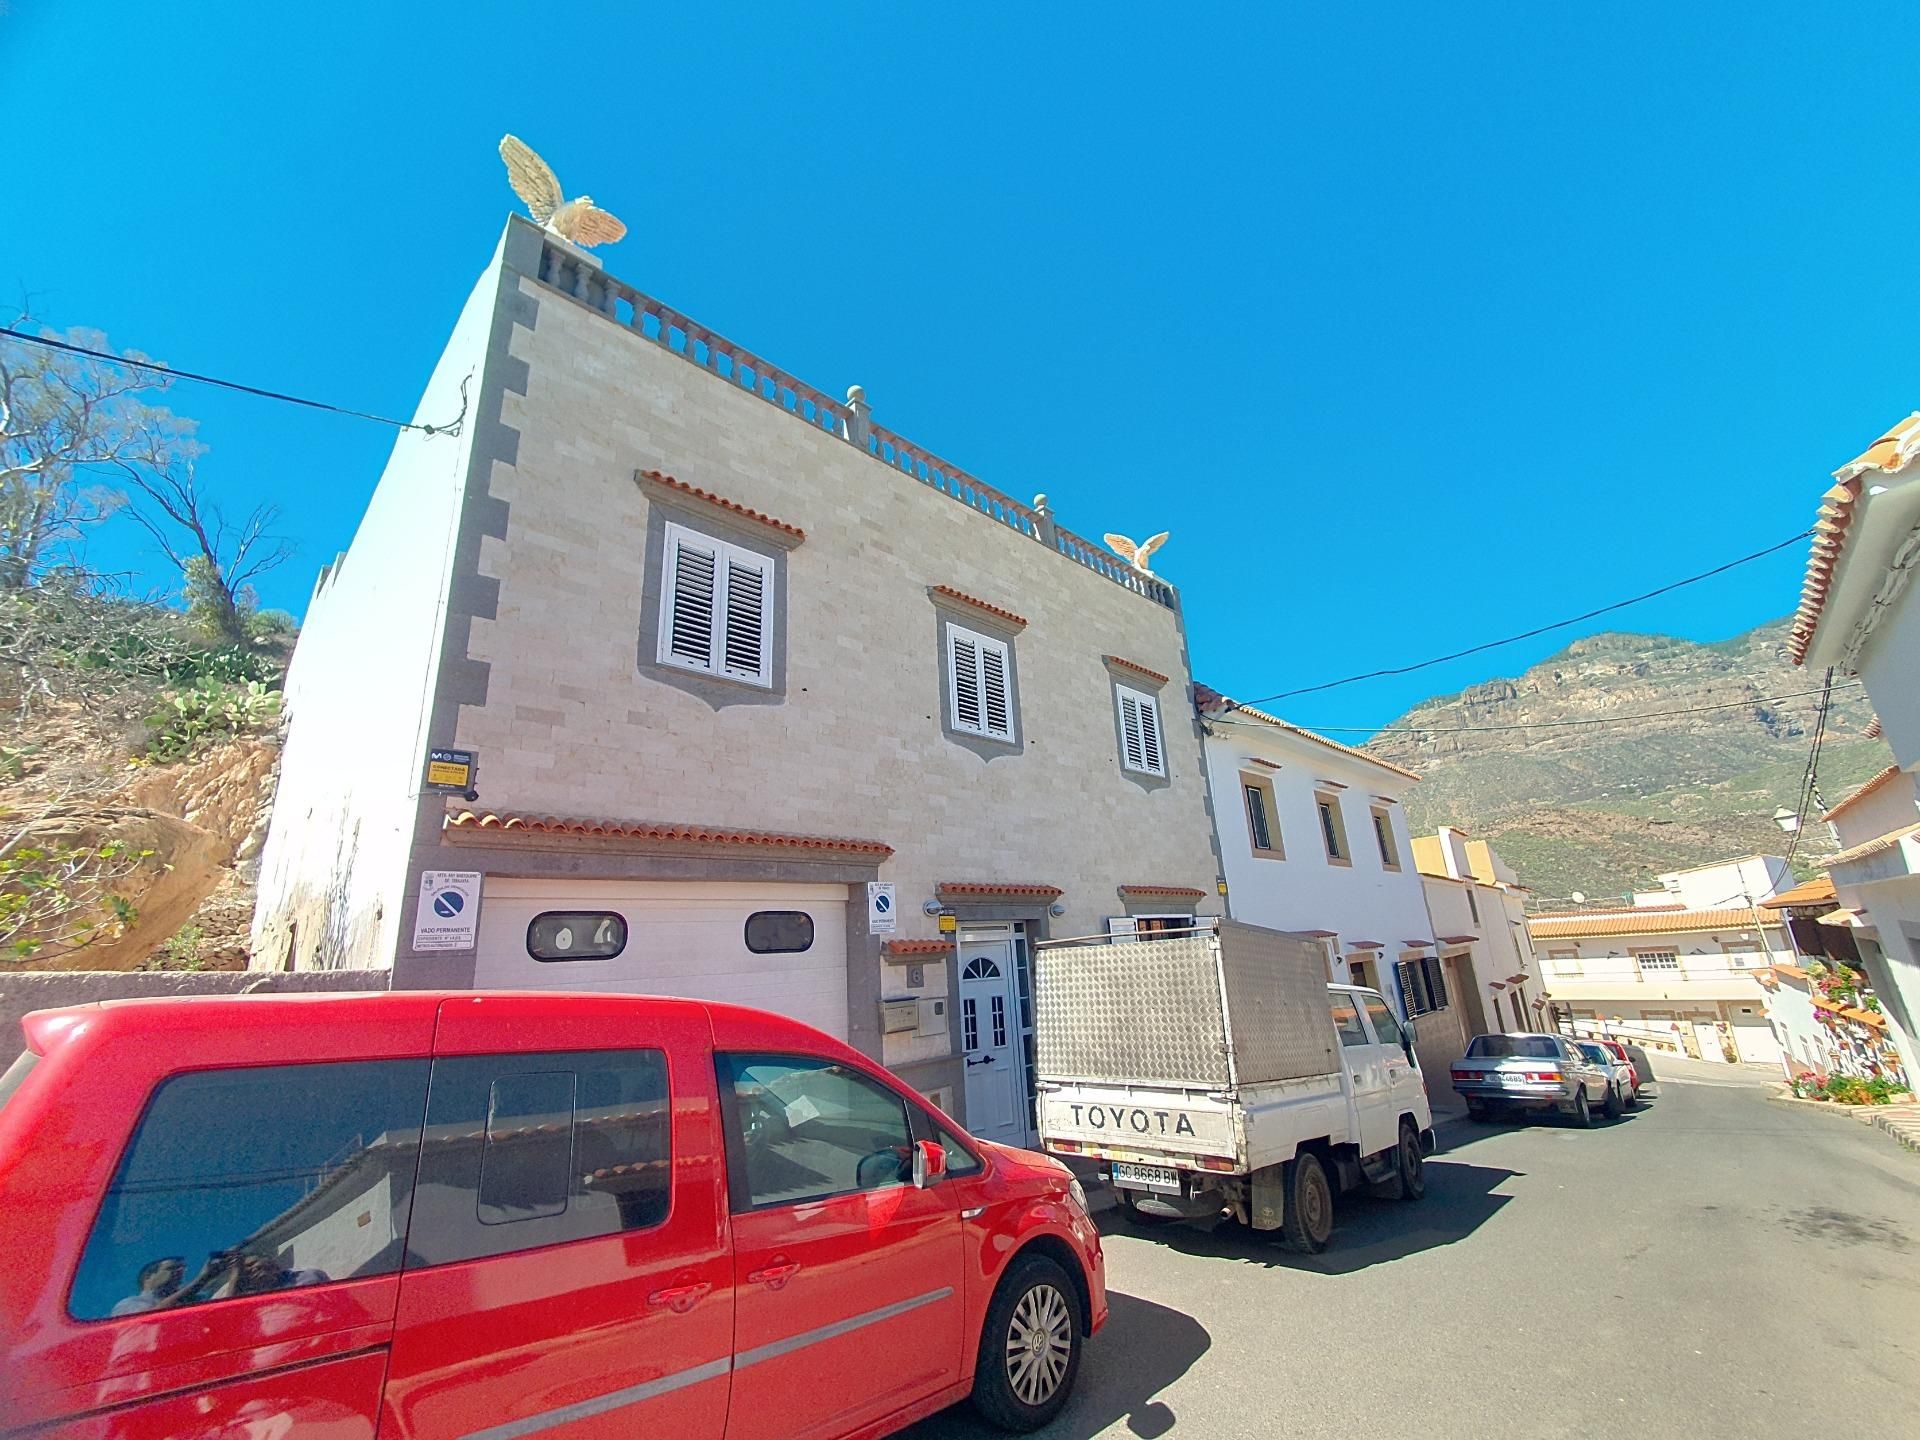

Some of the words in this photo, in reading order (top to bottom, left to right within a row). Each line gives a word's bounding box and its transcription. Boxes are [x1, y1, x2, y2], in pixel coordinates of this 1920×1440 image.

[912, 968, 921, 984] 6
[1070, 1104, 1196, 1137] TOYOTA
[1119, 1165, 1131, 1179] GC
[1134, 1167, 1161, 1183] 8668
